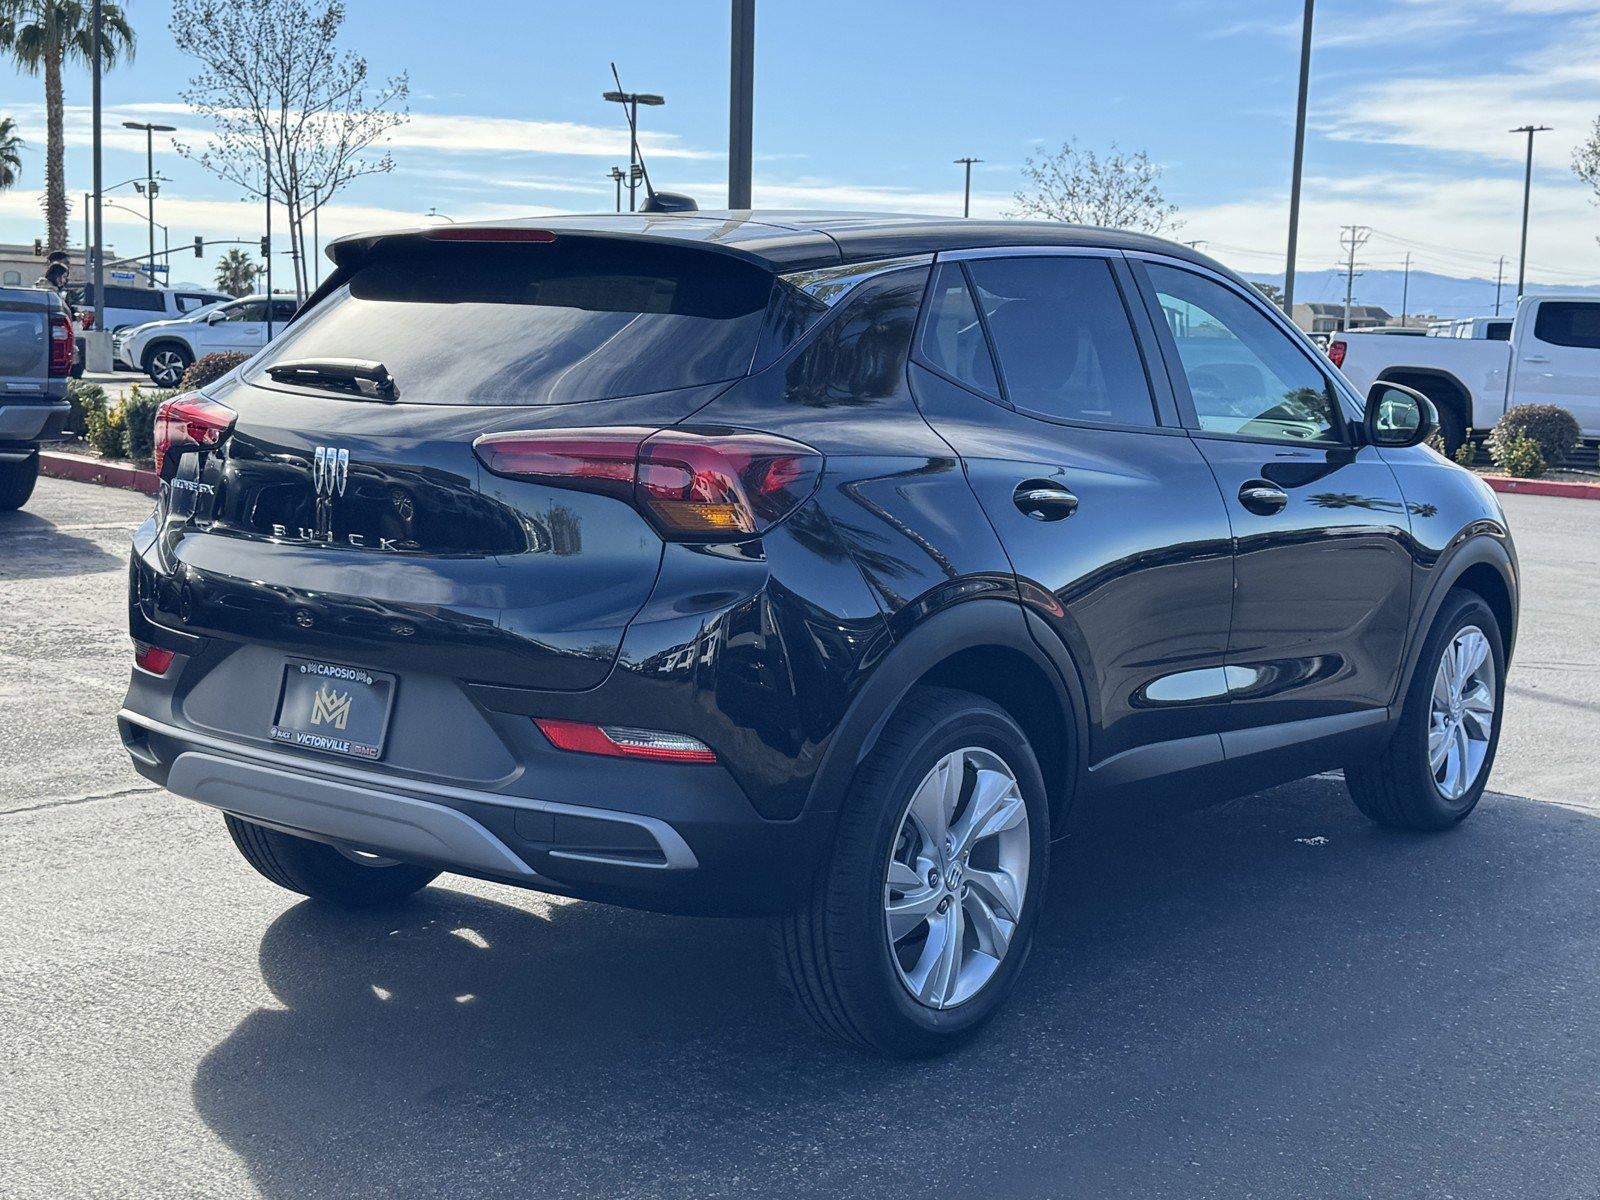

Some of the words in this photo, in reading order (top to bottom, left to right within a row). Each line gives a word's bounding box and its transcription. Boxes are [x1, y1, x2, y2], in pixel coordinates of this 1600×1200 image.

[272, 523, 400, 552] BUICK
[317, 664, 356, 680] CAPOSIO
[297, 732, 350, 752] VICTORVILLE
